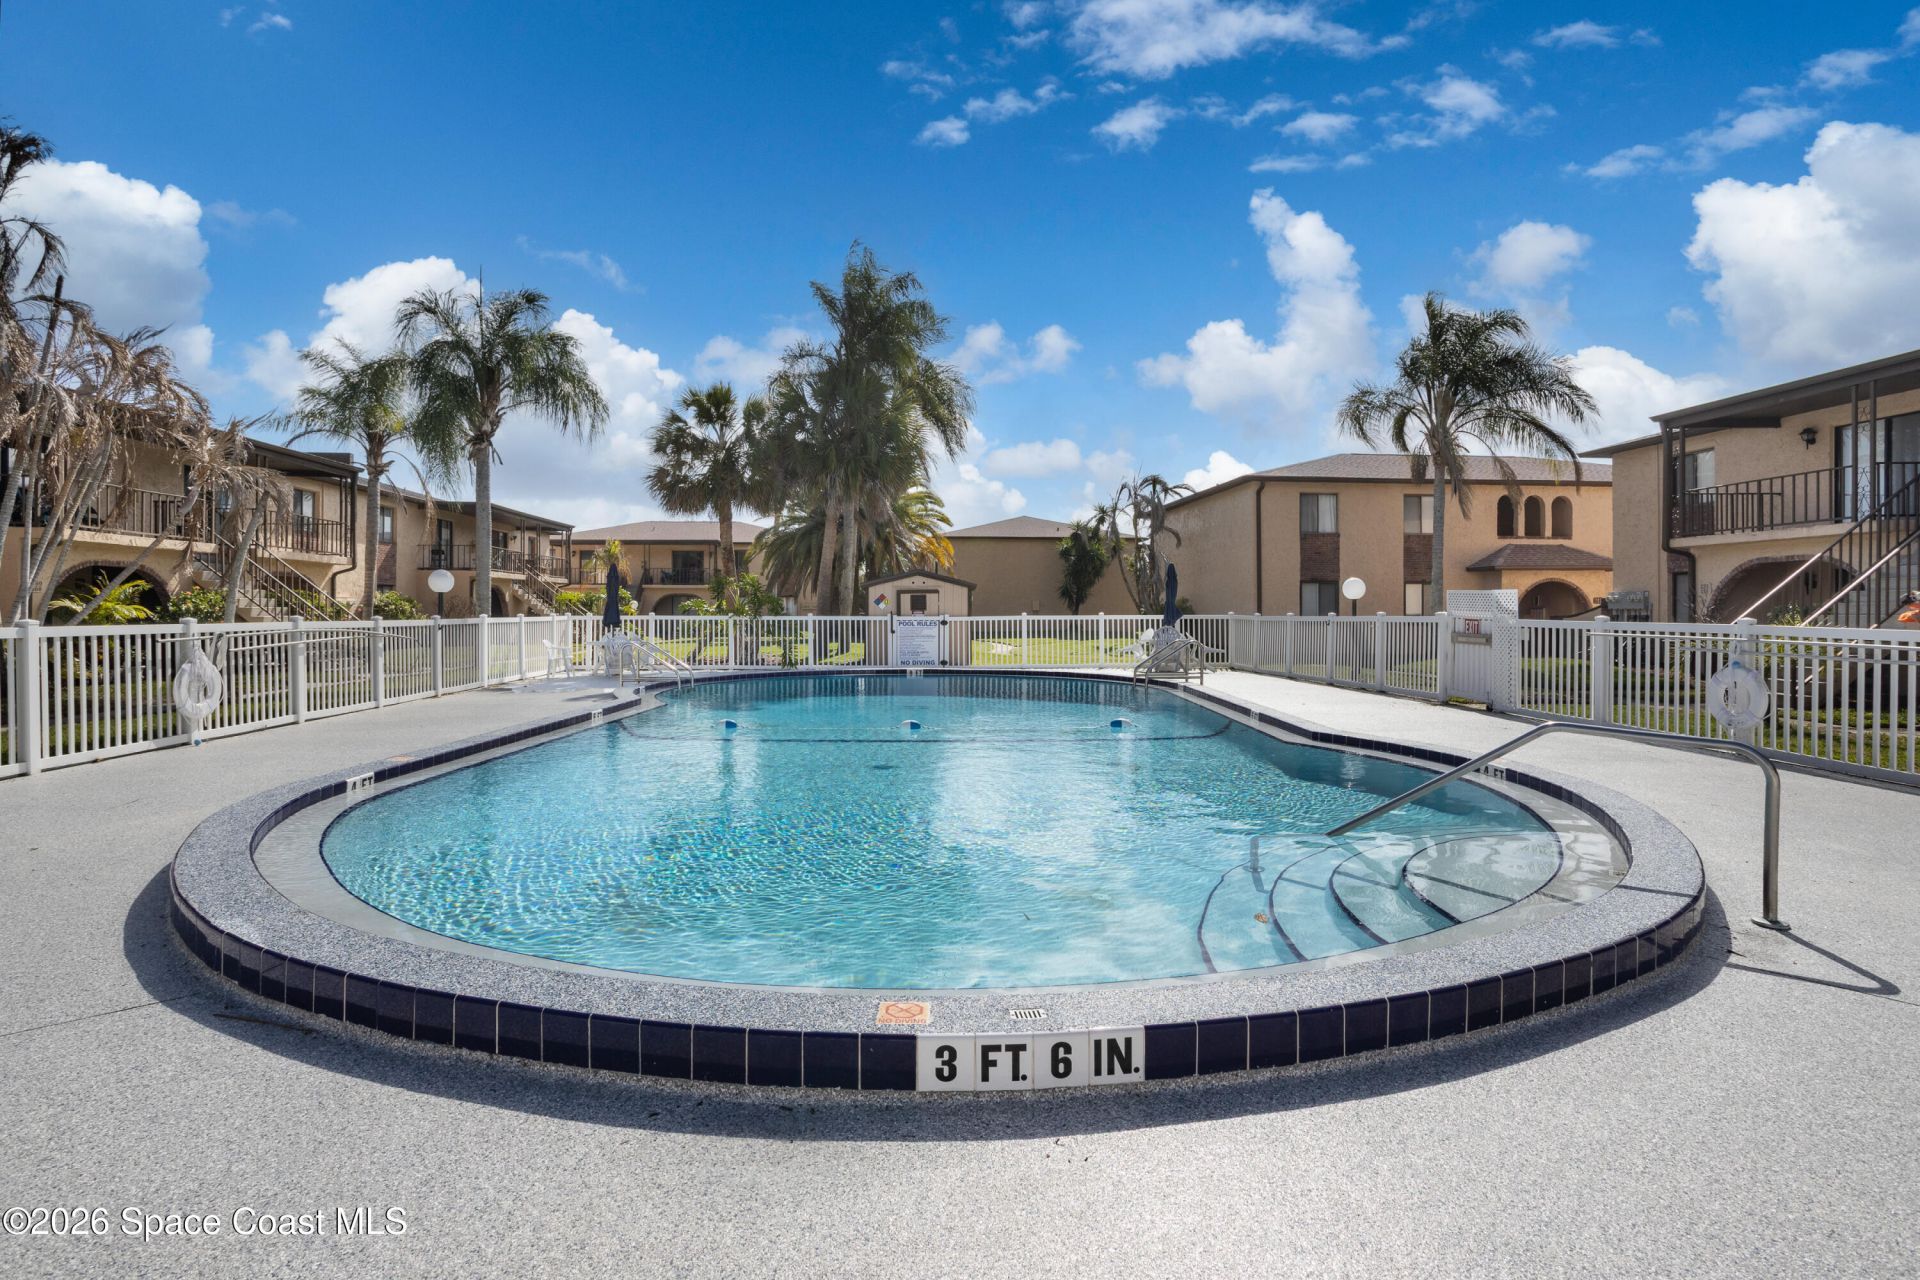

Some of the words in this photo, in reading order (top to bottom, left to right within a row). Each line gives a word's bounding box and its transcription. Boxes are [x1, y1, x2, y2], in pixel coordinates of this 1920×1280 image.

[1466, 620, 1479, 634] EXIT
[1493, 768, 1504, 780] FT
[361, 776, 373, 787] FT
[935, 1044, 958, 1083] 3
[981, 1043, 1027, 1082] FT.
[1050, 1041, 1073, 1079] 6
[1093, 1037, 1140, 1077] IN.
